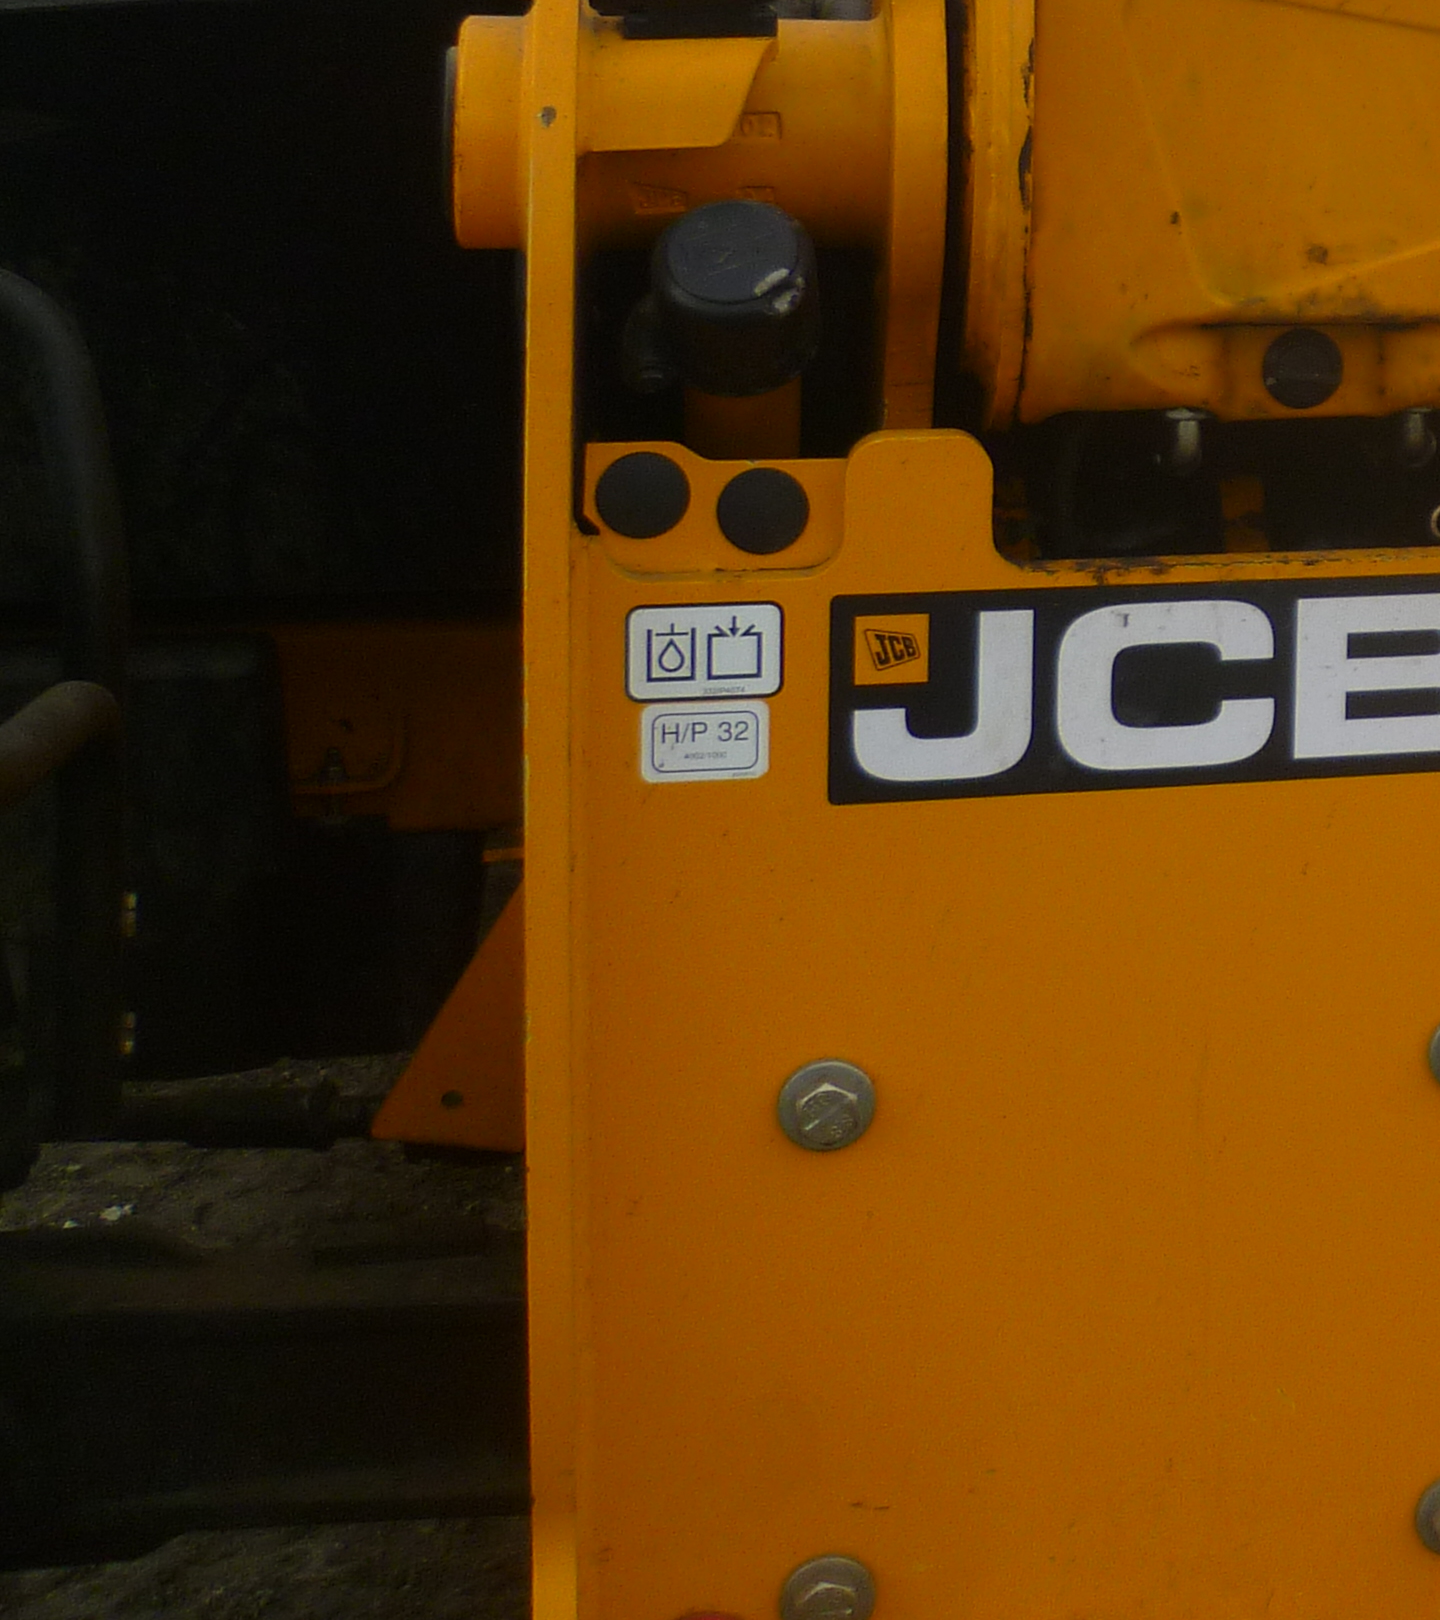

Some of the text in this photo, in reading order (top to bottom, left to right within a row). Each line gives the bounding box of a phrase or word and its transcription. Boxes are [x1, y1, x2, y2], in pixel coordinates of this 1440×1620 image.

[874, 633, 917, 666] JCB
[660, 721, 750, 744] H/P 32
